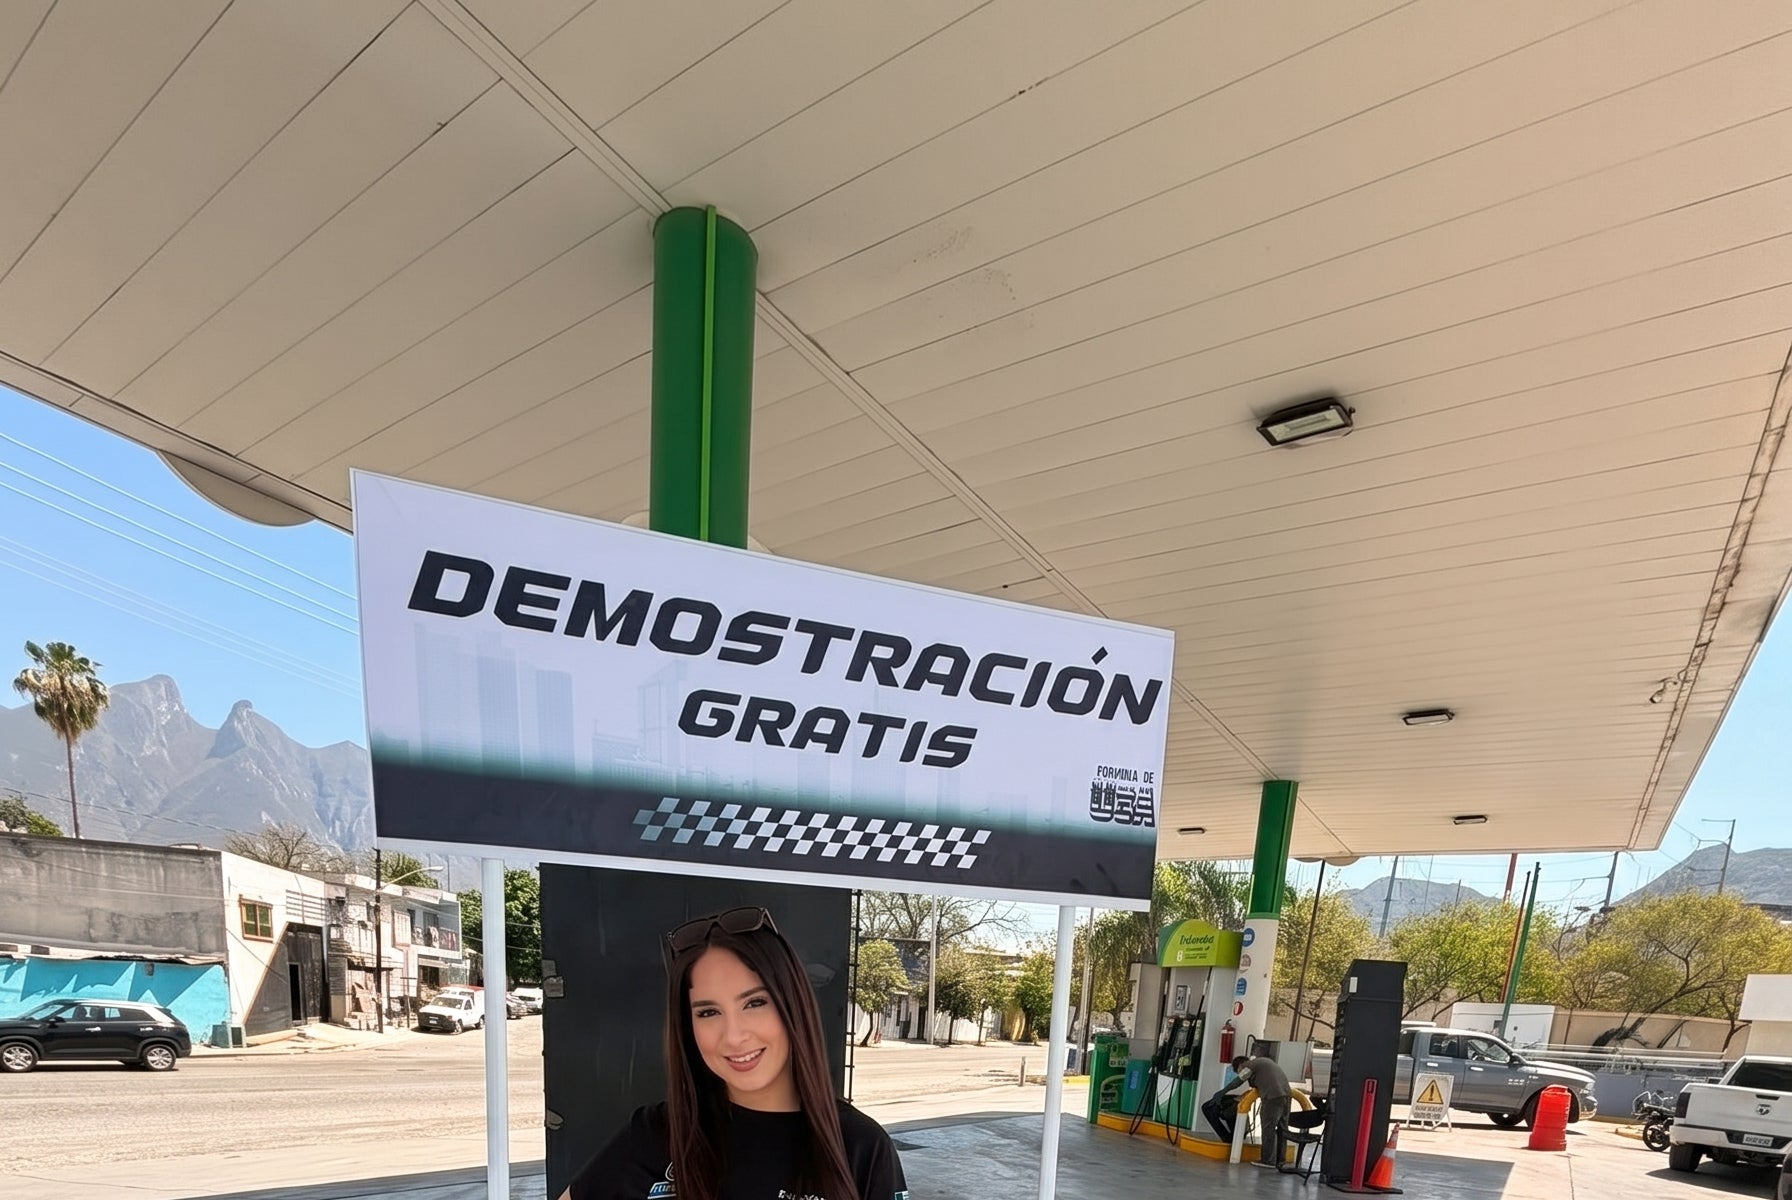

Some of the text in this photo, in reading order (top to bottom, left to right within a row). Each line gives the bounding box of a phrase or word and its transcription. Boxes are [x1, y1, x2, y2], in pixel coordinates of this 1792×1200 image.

[407, 549, 1164, 726] DEMOSTRACIÓN
[678, 689, 978, 769] GRATIS
[1143, 771, 1155, 784] DE
